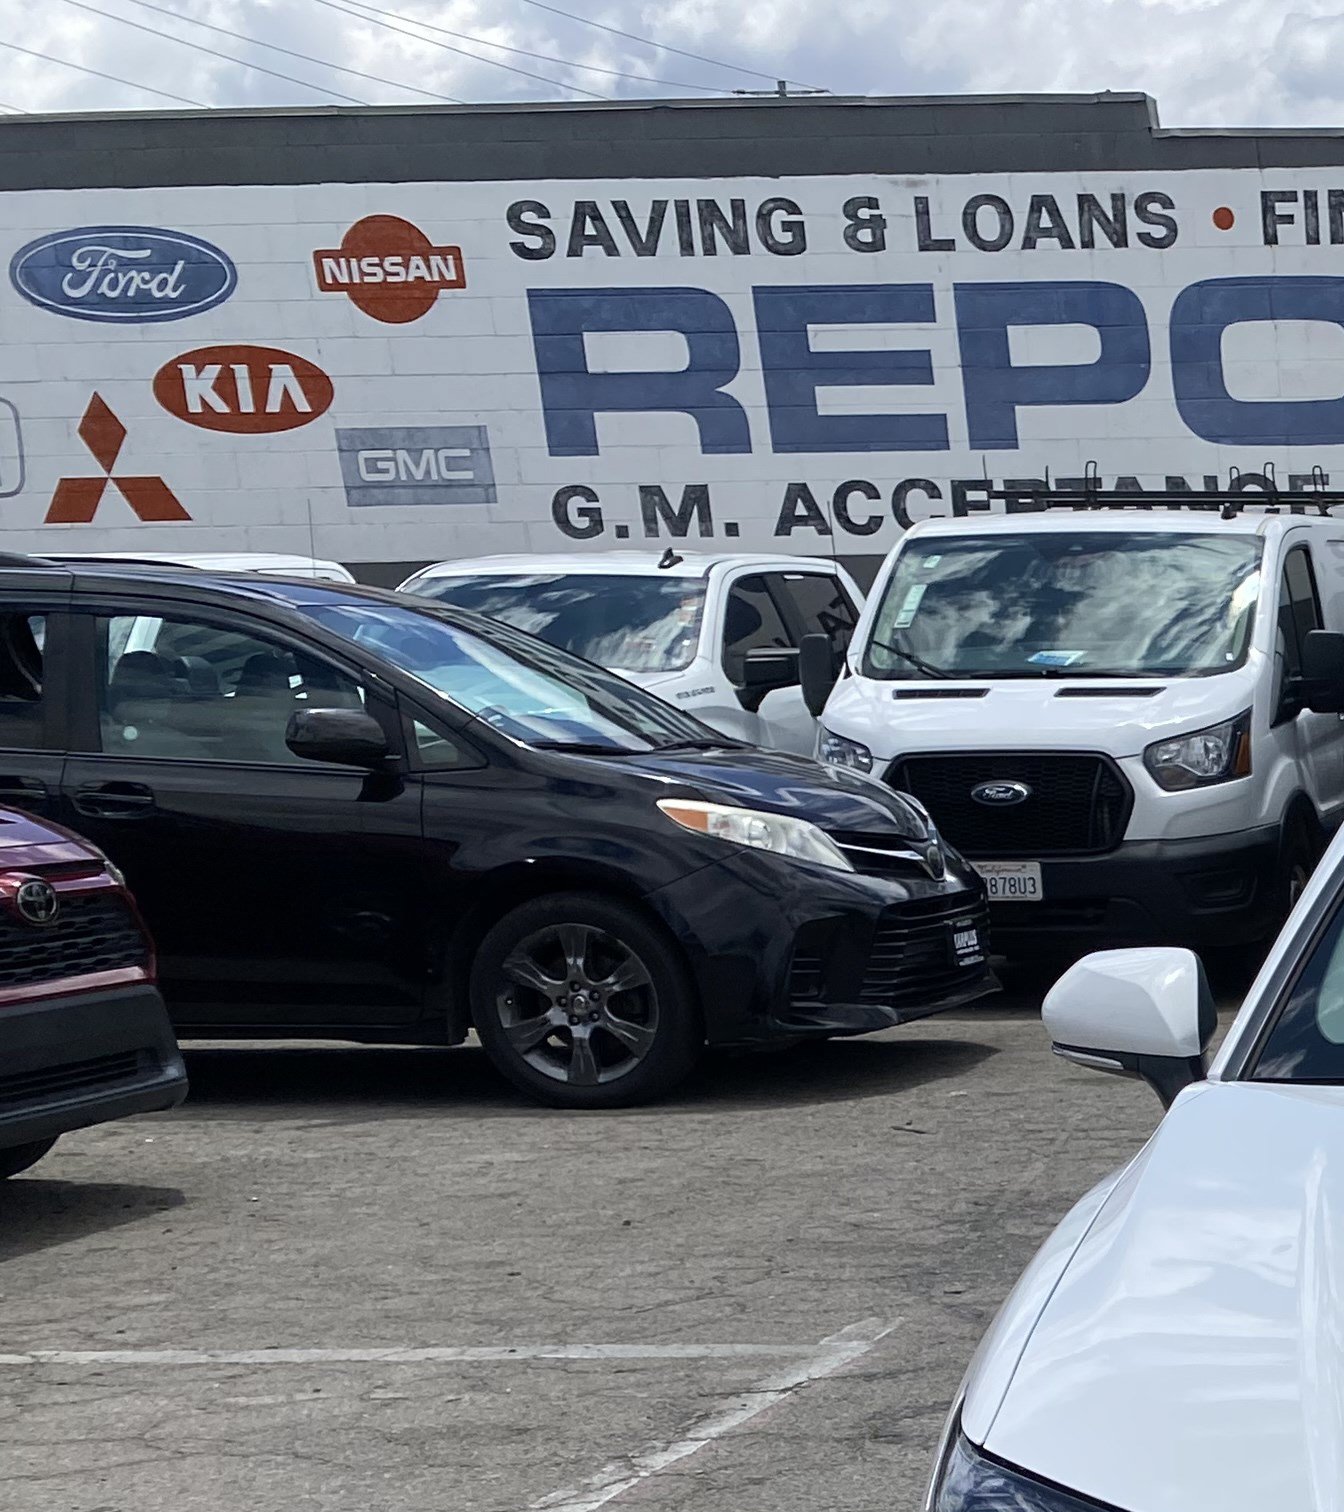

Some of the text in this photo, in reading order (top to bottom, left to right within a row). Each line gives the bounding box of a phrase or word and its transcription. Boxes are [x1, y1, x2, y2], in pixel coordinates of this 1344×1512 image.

[506, 197, 807, 261] SAVING
[842, 195, 888, 254] &
[913, 191, 1179, 253] LOANS
[62, 245, 186, 299] Ford
[321, 255, 457, 284] NISSAN
[177, 364, 313, 413] KIA
[357, 448, 475, 482] GMC
[551, 484, 740, 540] G.M.
